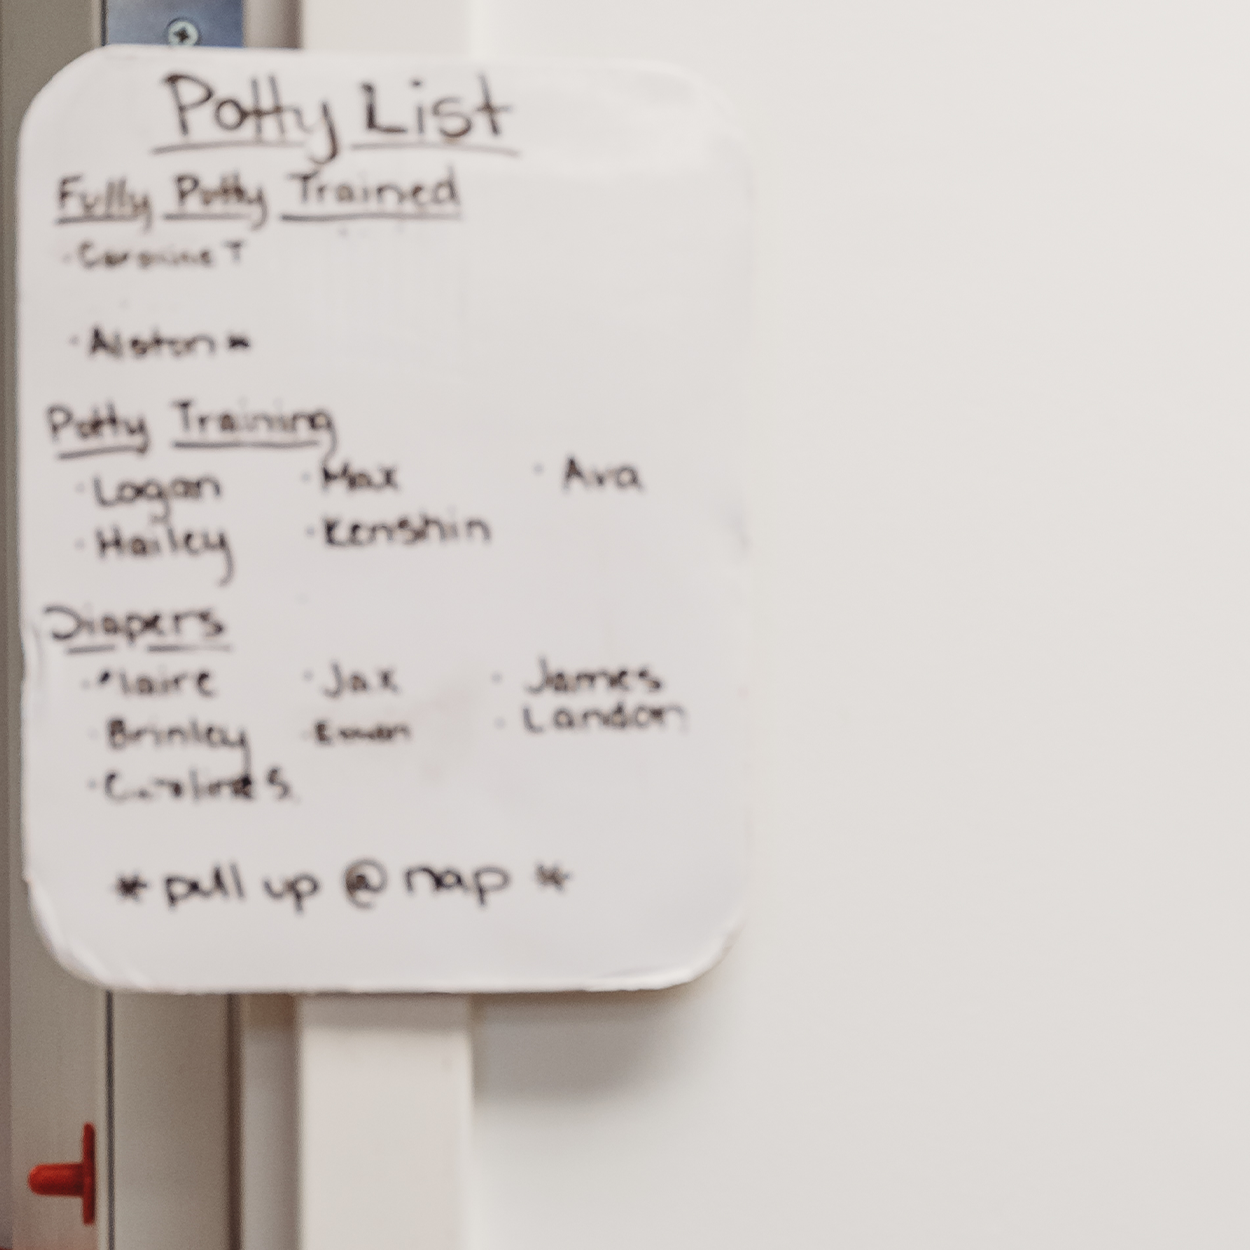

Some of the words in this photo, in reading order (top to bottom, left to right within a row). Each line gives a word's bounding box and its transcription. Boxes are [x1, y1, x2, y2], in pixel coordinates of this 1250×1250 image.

[164, 72, 341, 165] Potty
[361, 72, 513, 141] List
[56, 175, 154, 232] Fully
[175, 173, 270, 230] Potty
[288, 165, 462, 208] Trained
[47, 403, 150, 454] Potty
[172, 401, 337, 462] Training
[95, 474, 222, 523] Logan
[319, 461, 400, 492] Max
[560, 456, 646, 493] Ava
[322, 513, 493, 548] Kenshin
[94, 527, 233, 586] Hailey
[43, 604, 228, 653] Diapers
[322, 662, 399, 699] Jax
[524, 656, 665, 697] James
[521, 701, 688, 734] Landon
[107, 718, 252, 775] Brinley
[162, 862, 246, 912] pull
[263, 867, 322, 917] up
[404, 862, 512, 911] nap
